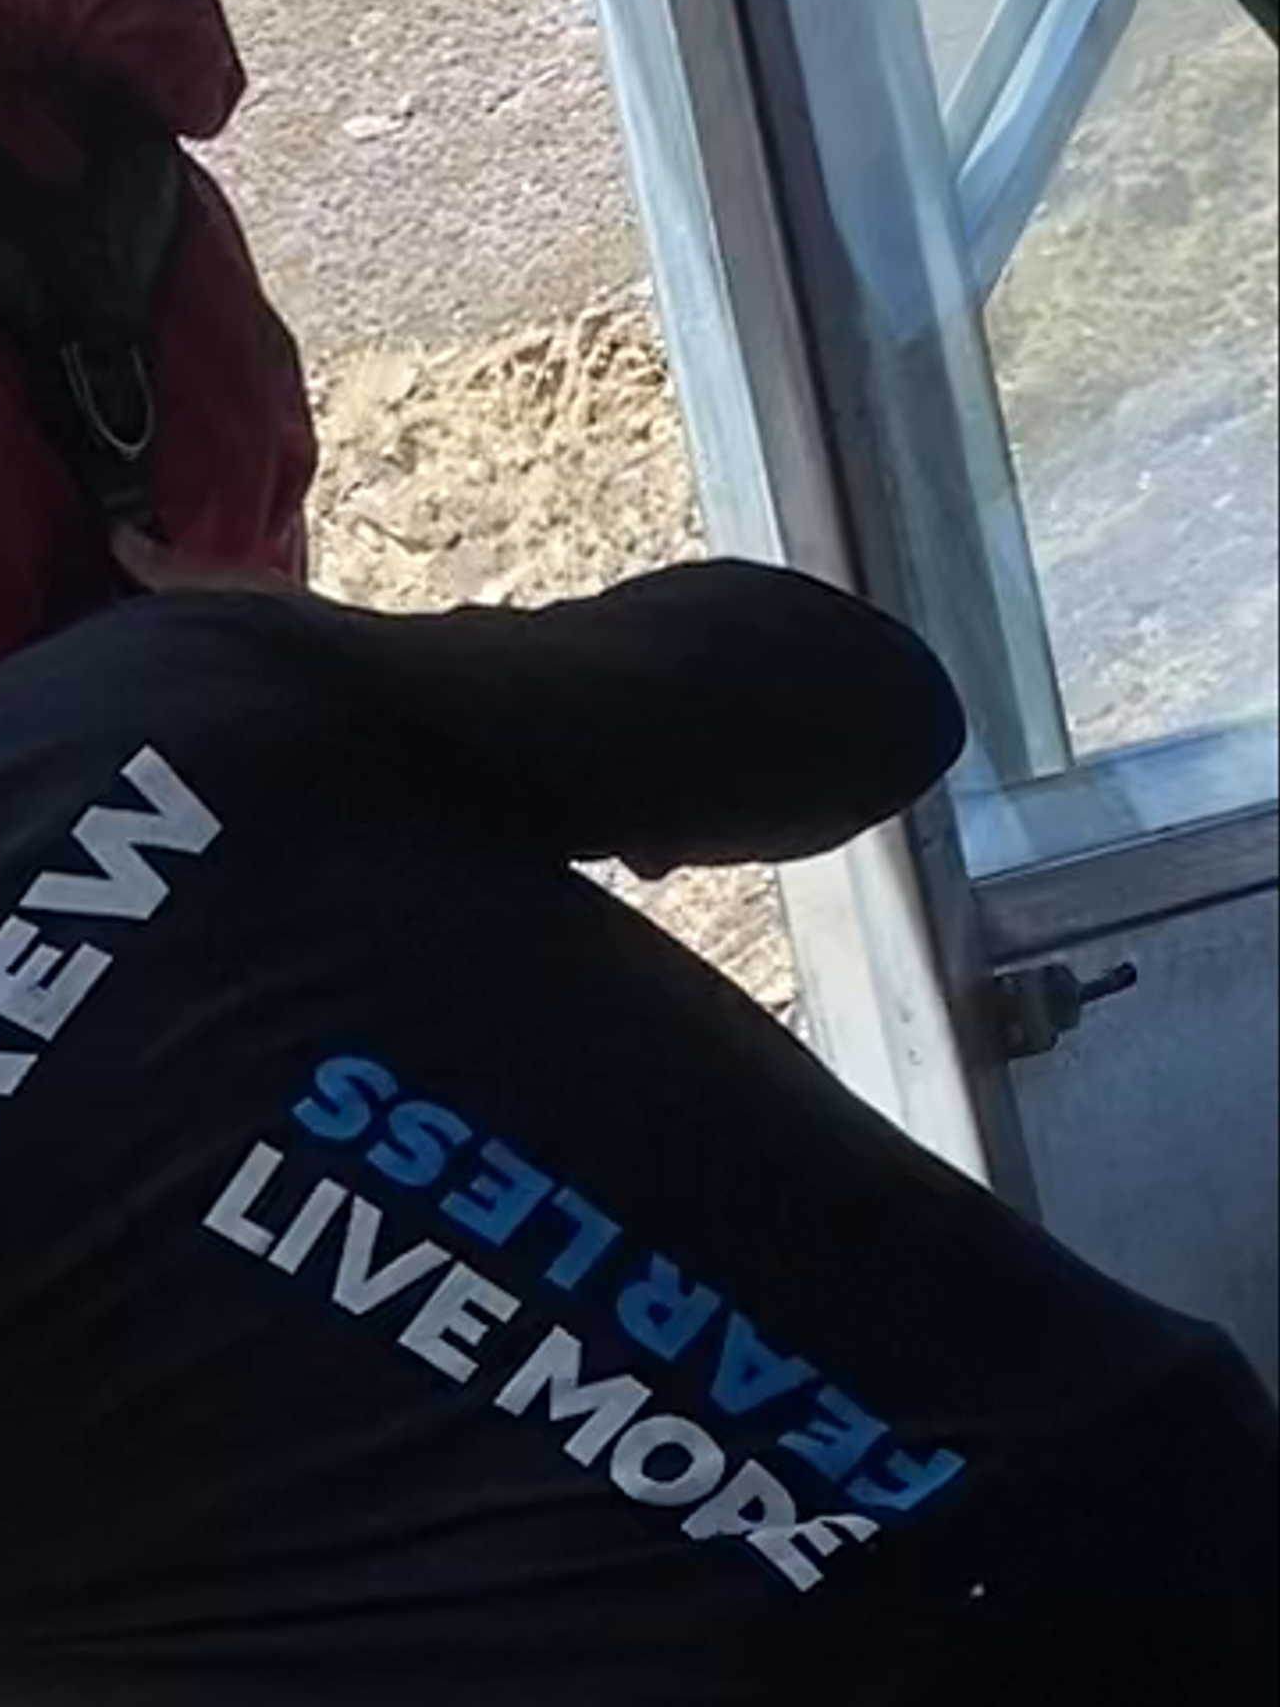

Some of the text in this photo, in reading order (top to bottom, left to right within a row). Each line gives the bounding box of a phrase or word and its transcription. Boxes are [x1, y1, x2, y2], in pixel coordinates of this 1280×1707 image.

[200, 1139, 880, 1593] LIVE MORE
[289, 1053, 967, 1515] FEAR LESS
